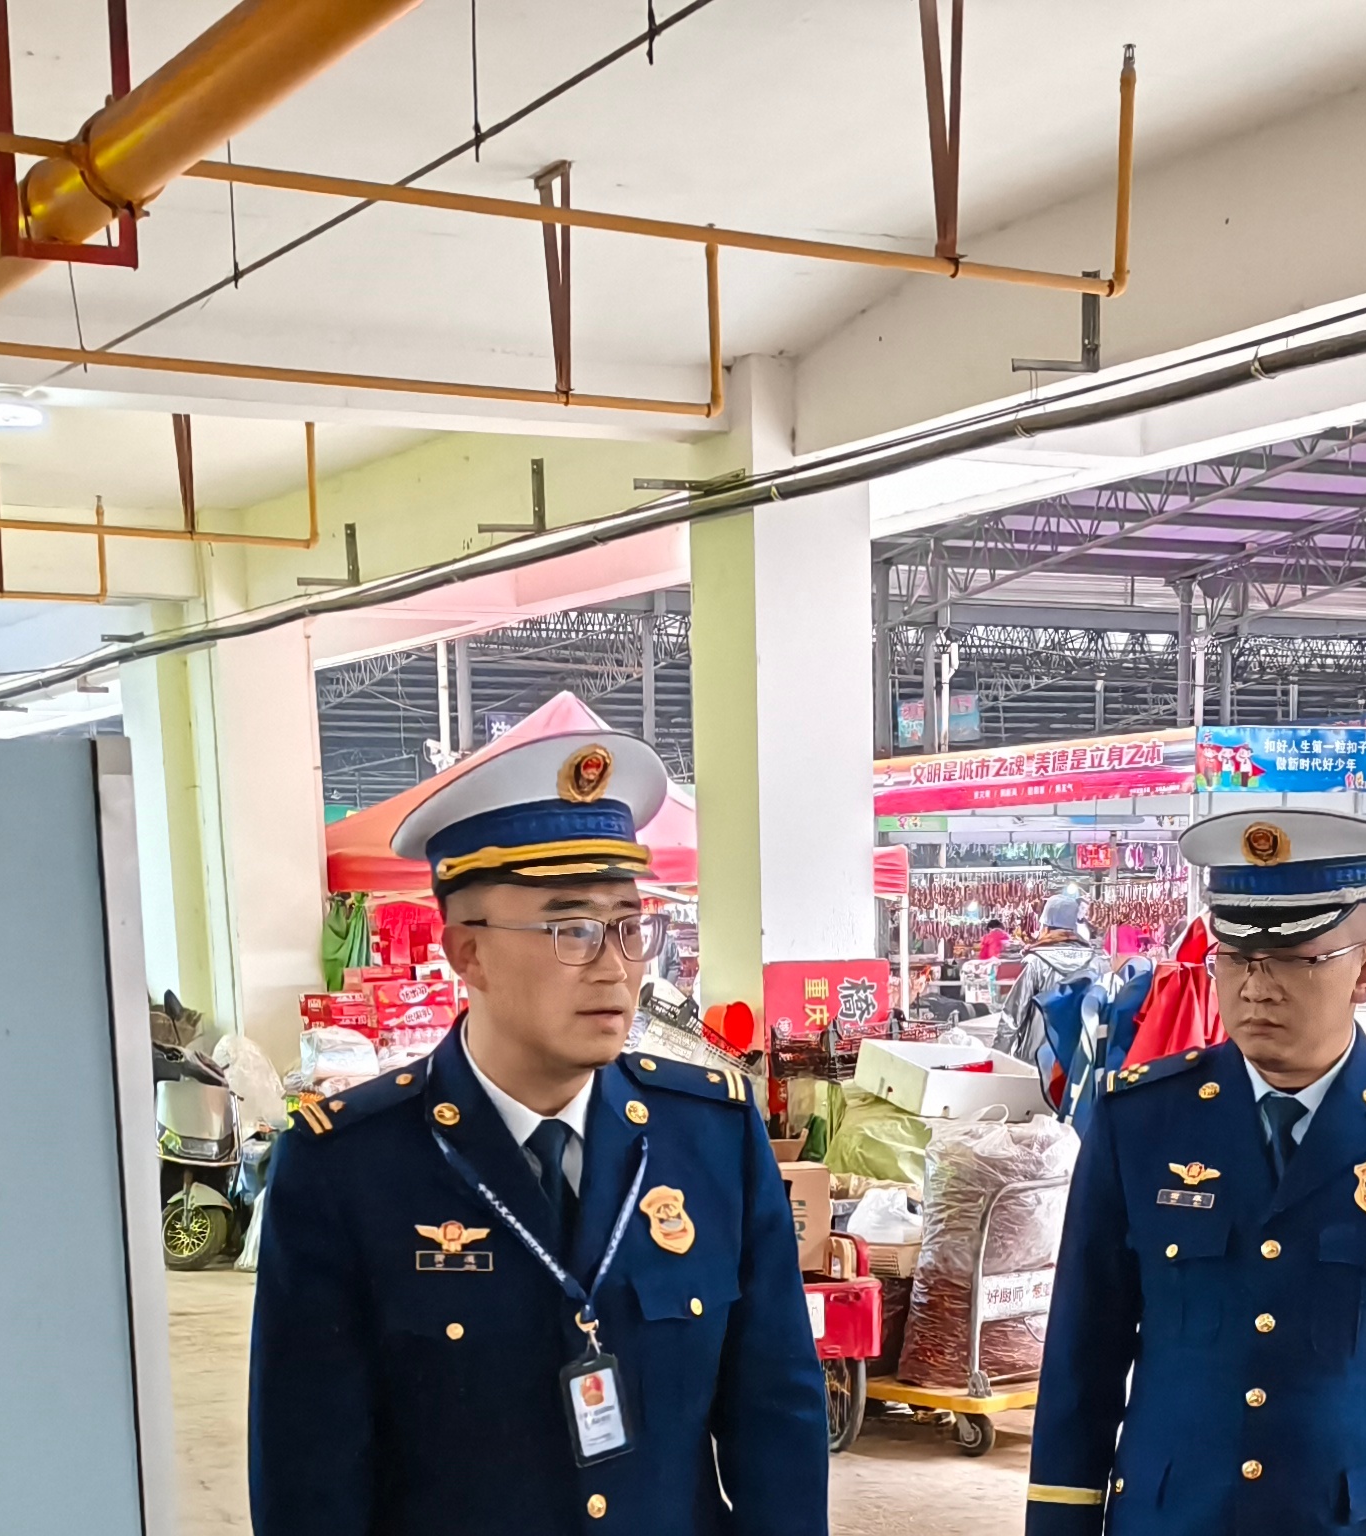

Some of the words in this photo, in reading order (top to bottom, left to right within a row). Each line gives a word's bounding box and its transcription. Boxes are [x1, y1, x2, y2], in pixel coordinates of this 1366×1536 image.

[911, 754, 1026, 786] 文明是城市之魂
[1034, 738, 1164, 777] 美德是立身之本
[1275, 756, 1357, 772] 做新时代好少年
[804, 976, 830, 1027] 重庆
